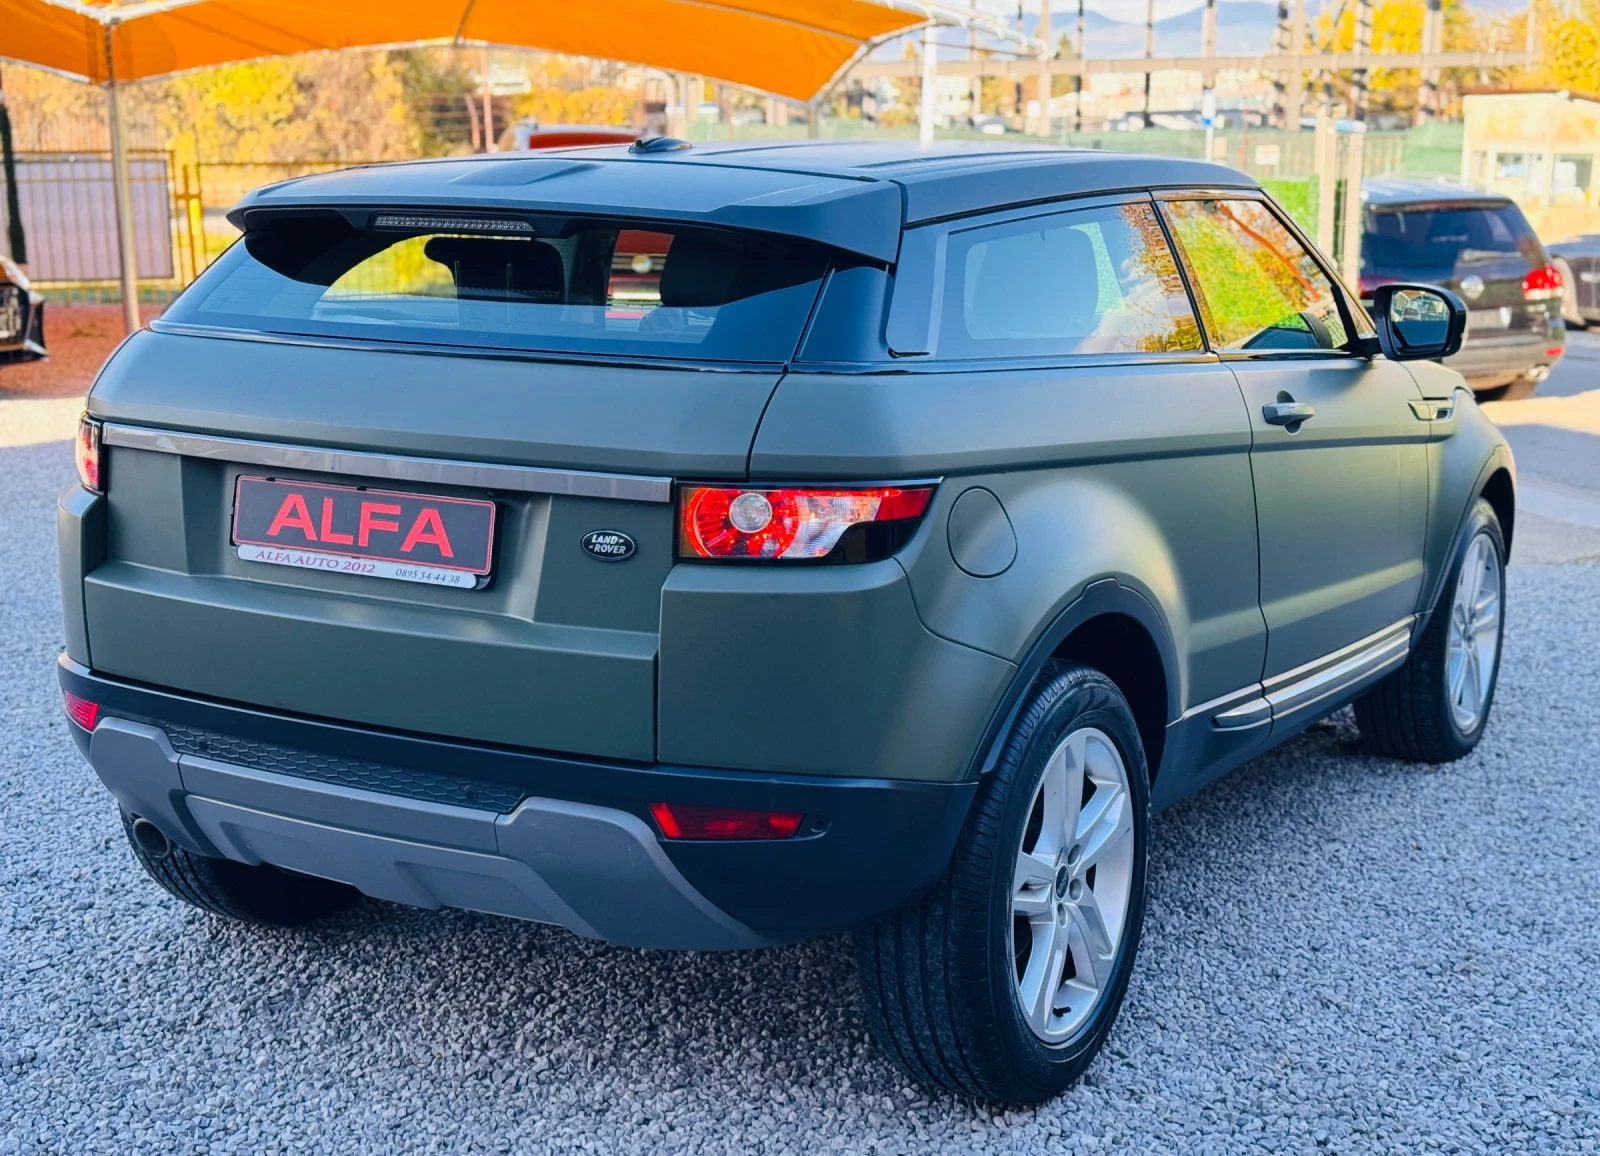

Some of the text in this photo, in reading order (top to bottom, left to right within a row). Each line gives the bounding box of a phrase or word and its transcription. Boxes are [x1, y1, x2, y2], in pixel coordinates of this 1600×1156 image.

[266, 493, 455, 558] ALFA
[593, 544, 627, 555] ROVER
[255, 550, 376, 574] ALFA AUTO 2012
[395, 568, 461, 584] 0895 54 44 38
